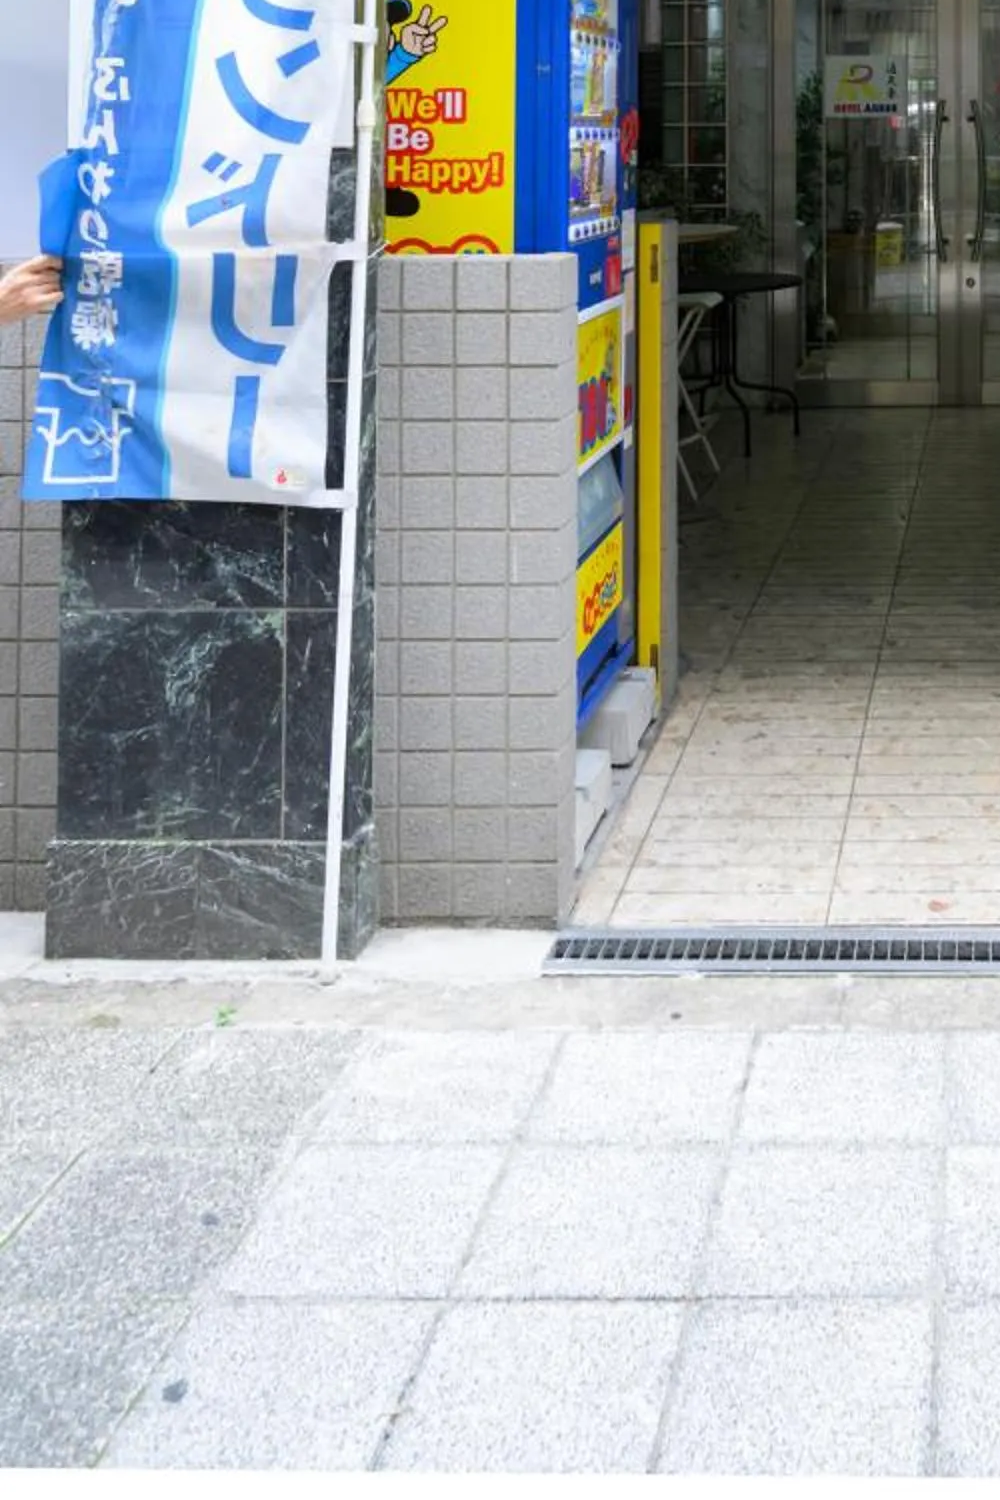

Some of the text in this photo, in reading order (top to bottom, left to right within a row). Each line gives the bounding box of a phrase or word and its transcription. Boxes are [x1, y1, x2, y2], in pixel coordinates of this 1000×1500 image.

[386, 89, 465, 121] We'll
[386, 123, 431, 152] Be
[386, 153, 502, 190] Happy!
